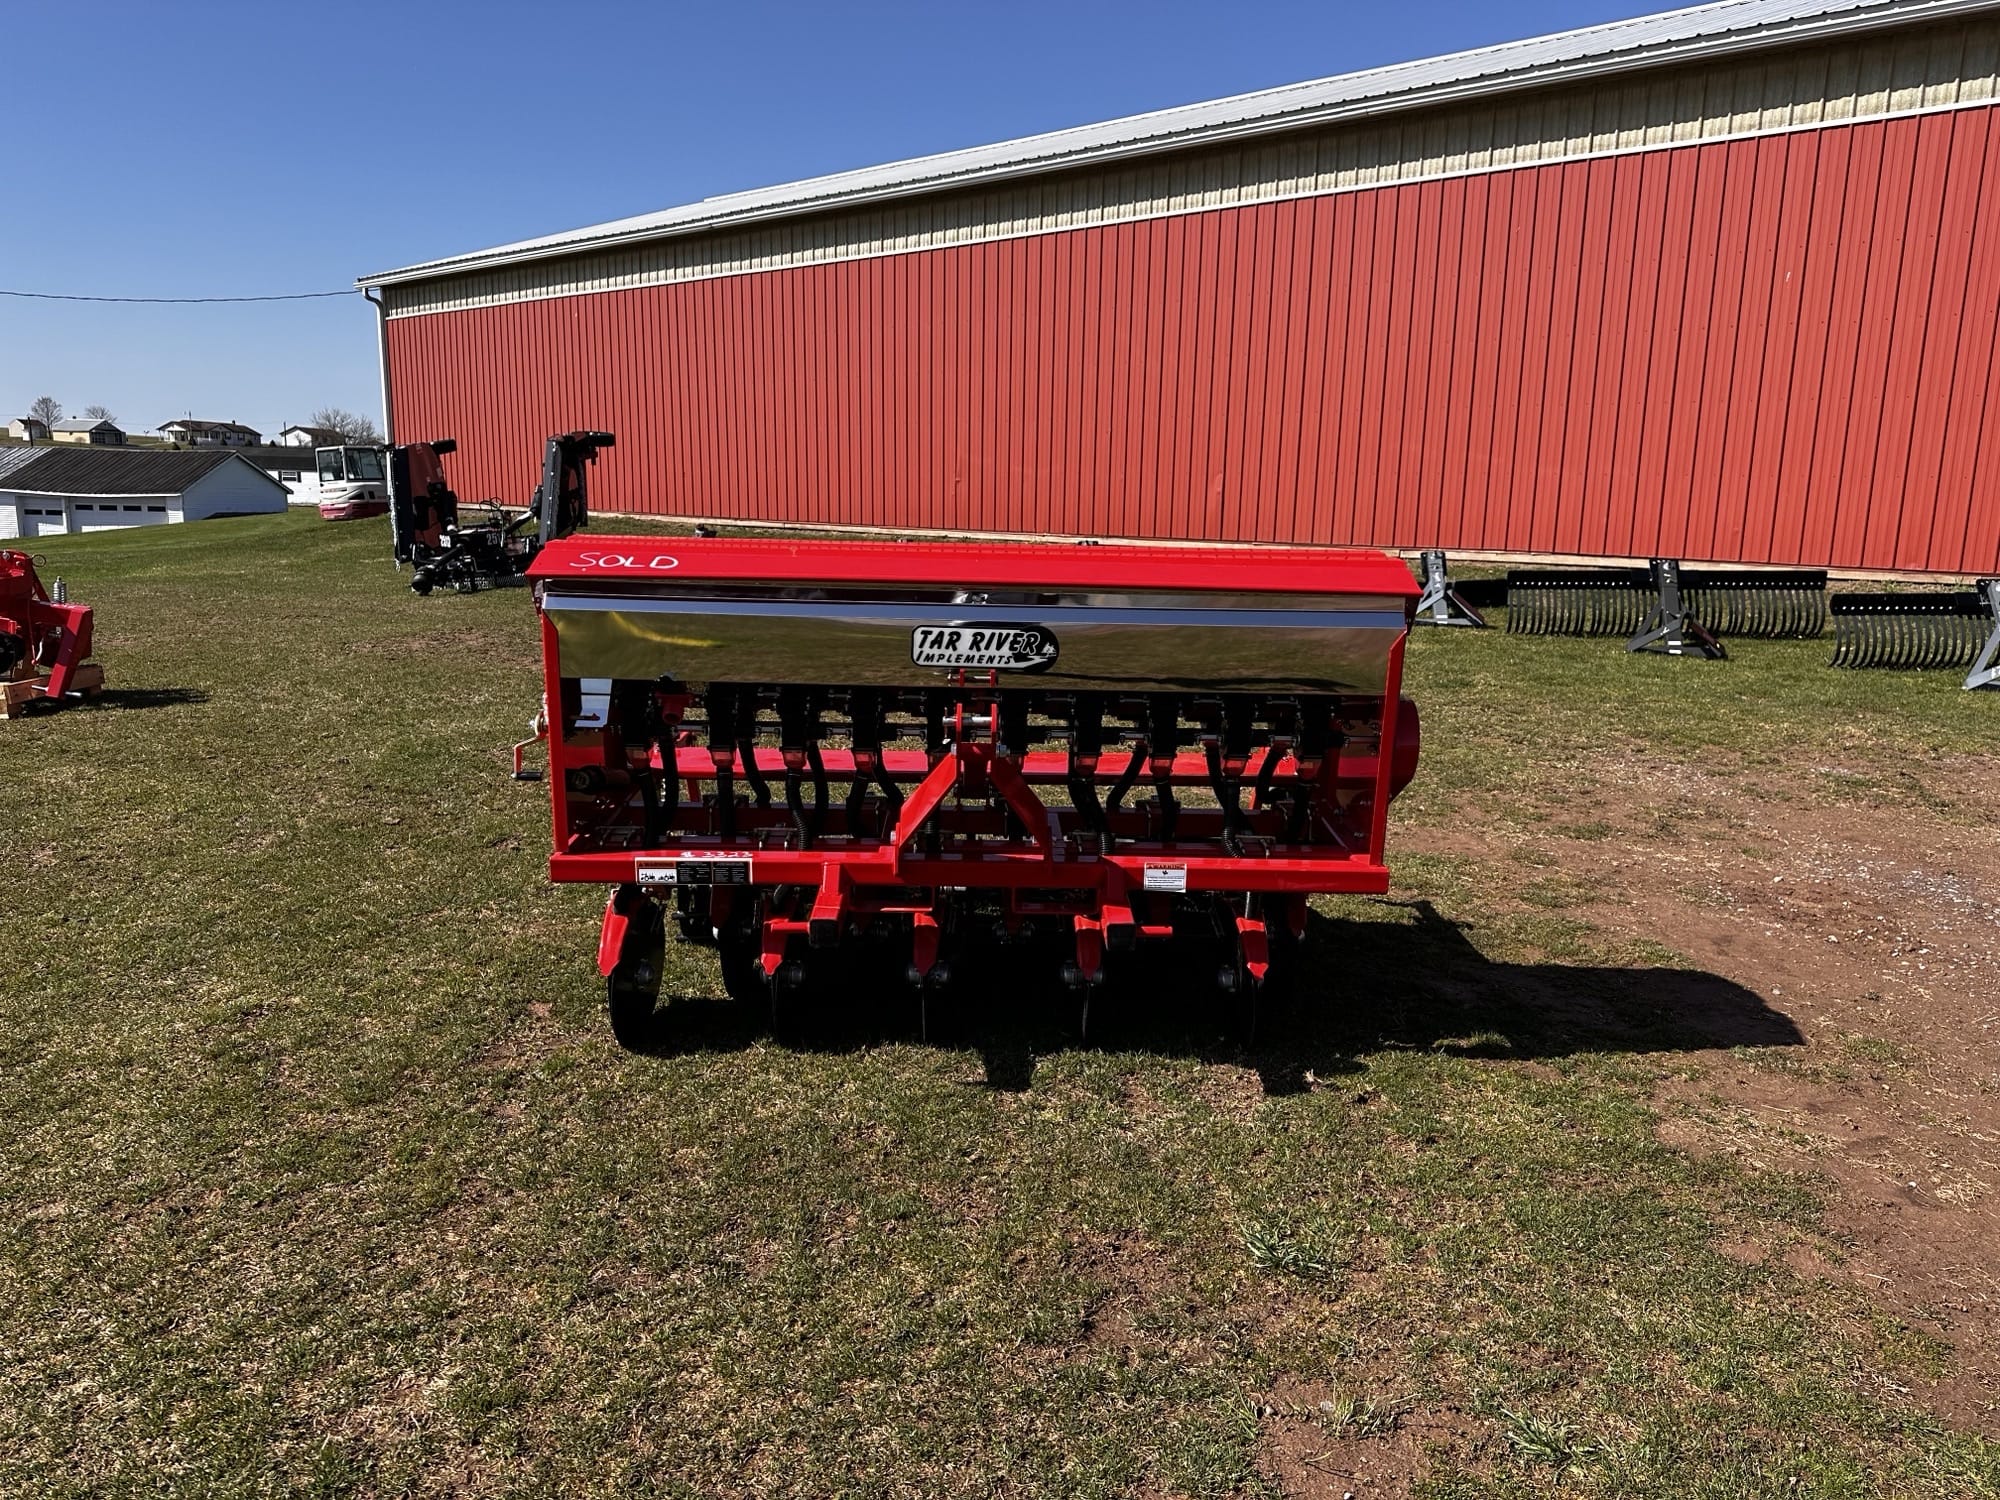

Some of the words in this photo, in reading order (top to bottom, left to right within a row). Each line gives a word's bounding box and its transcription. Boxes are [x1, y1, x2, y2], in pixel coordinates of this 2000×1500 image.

[569, 552, 679, 569] SOLD
[918, 630, 961, 652] TAR
[968, 631, 1041, 655] RIVER
[915, 650, 1014, 665] IMPLEMENTS
